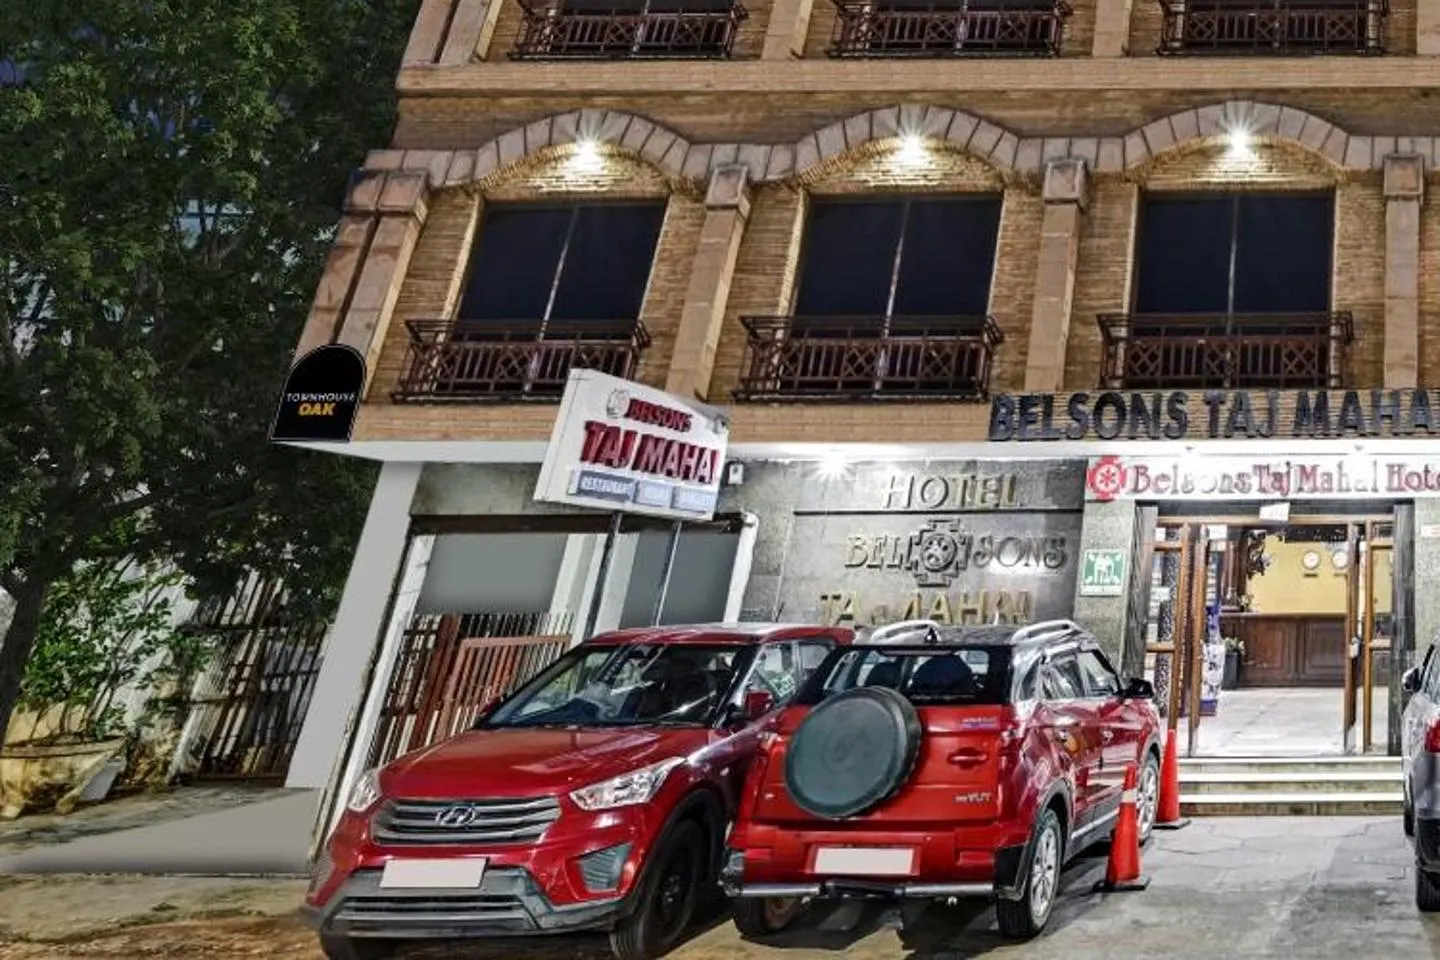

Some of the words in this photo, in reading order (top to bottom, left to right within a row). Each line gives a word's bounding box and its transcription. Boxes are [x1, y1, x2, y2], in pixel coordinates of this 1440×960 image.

[299, 402, 336, 416] OAK
[624, 398, 693, 433] BELSONS
[990, 390, 1189, 440] BELSONS
[1205, 390, 1278, 439] TAJ
[580, 420, 637, 469] TAJ
[883, 474, 1019, 510] HOTEL
[1254, 461, 1292, 497] Taj
